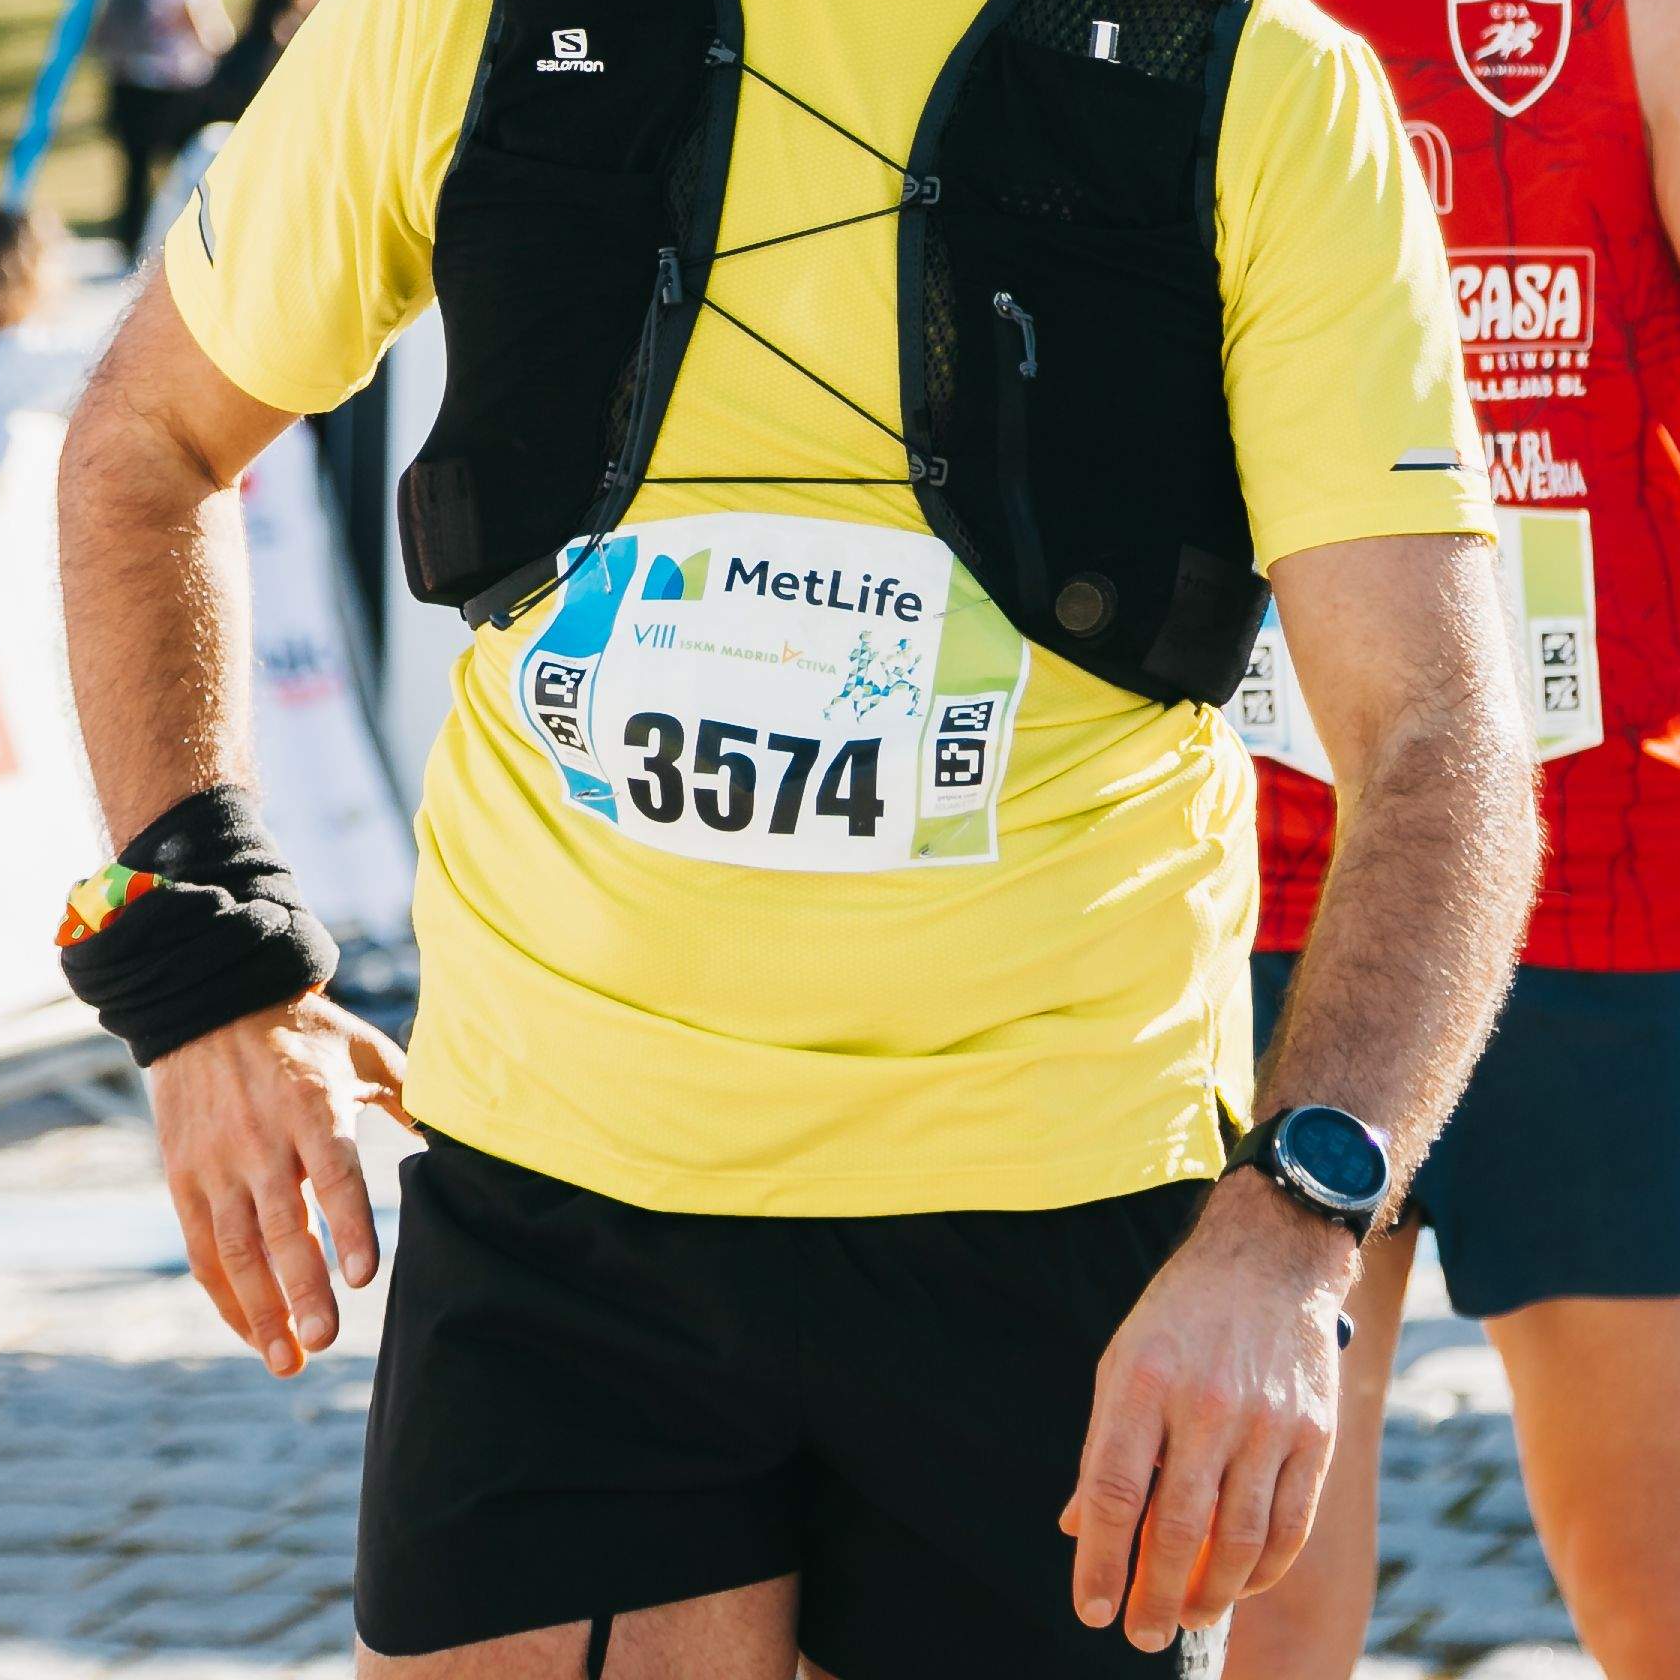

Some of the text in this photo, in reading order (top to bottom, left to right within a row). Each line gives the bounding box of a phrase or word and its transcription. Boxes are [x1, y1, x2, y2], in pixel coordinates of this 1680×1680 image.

[1451, 265, 1581, 341] CASA
[724, 556, 923, 622] MetLife
[634, 623, 677, 648] VIII
[720, 645, 780, 664] MADRID
[623, 711, 885, 837] 3574
